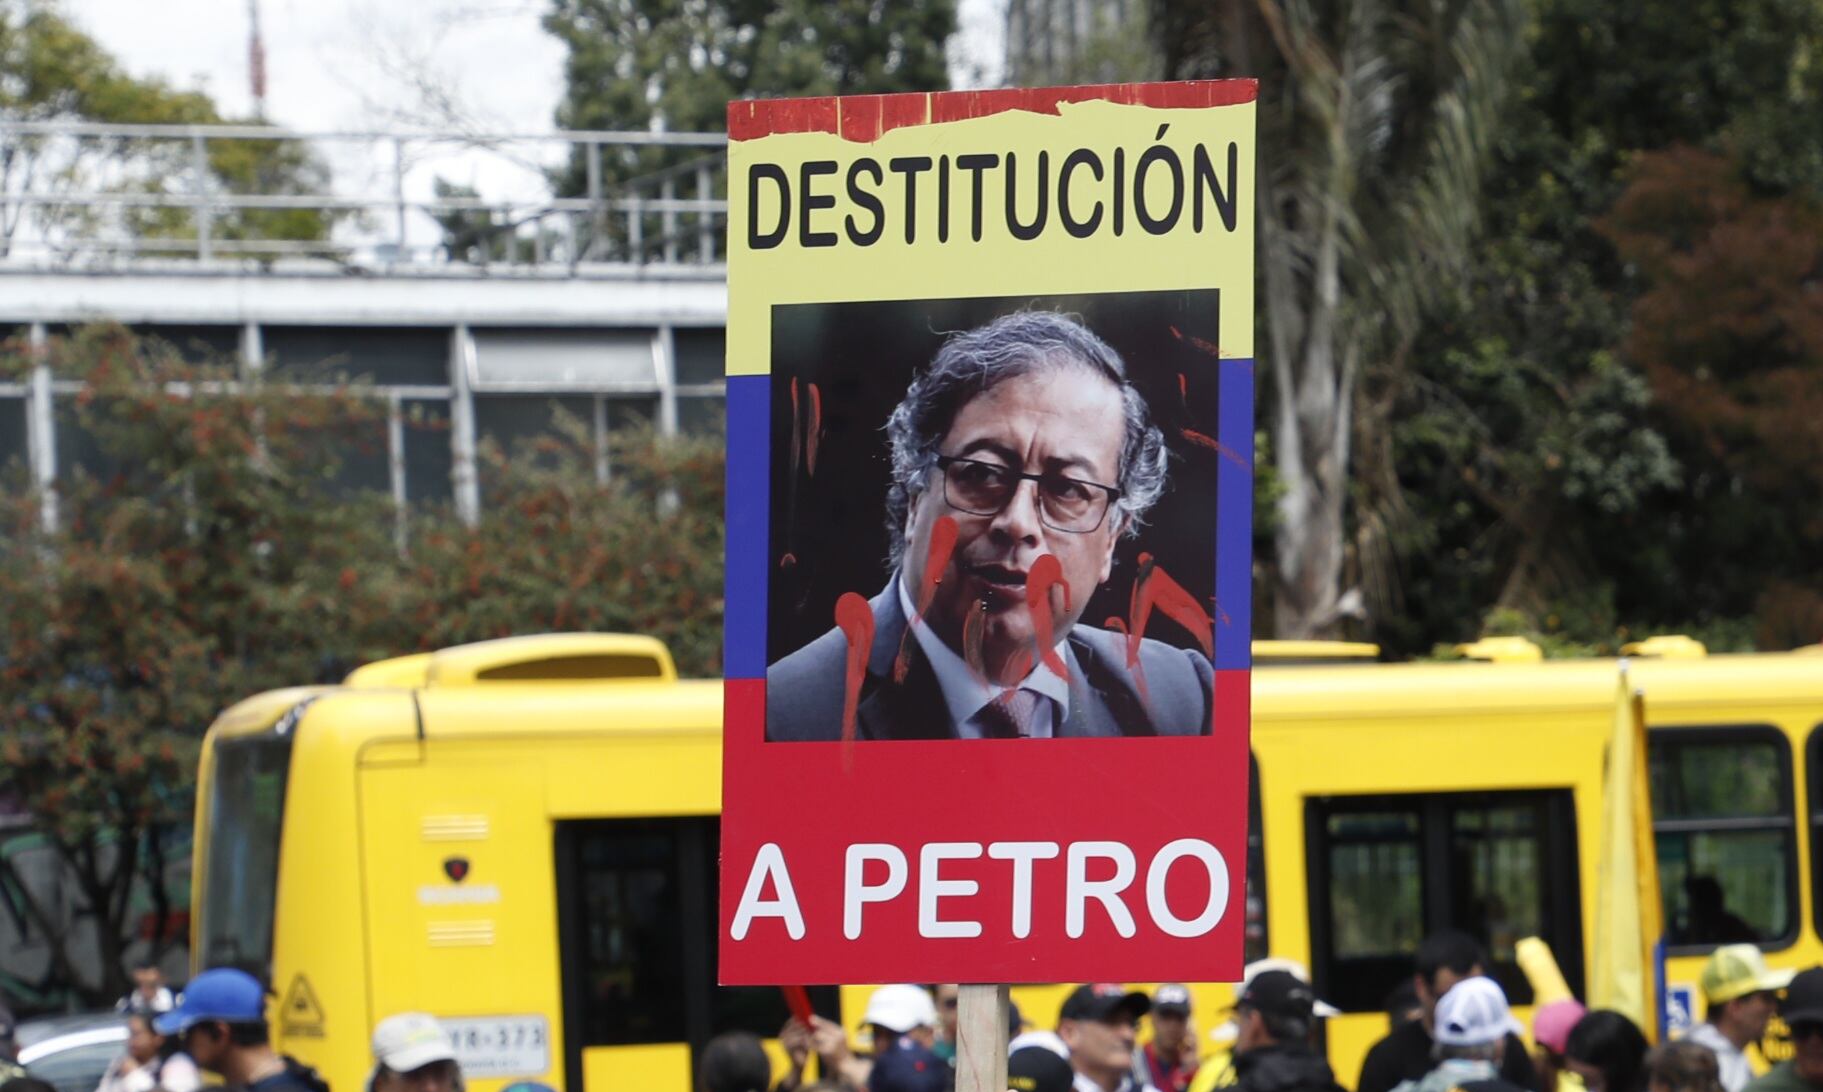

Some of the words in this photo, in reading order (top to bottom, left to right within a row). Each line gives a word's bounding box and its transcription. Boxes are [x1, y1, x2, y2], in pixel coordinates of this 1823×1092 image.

[747, 124, 1239, 250] DESTITUCIÓN
[729, 842, 806, 941] A
[841, 838, 1231, 941] PETRO
